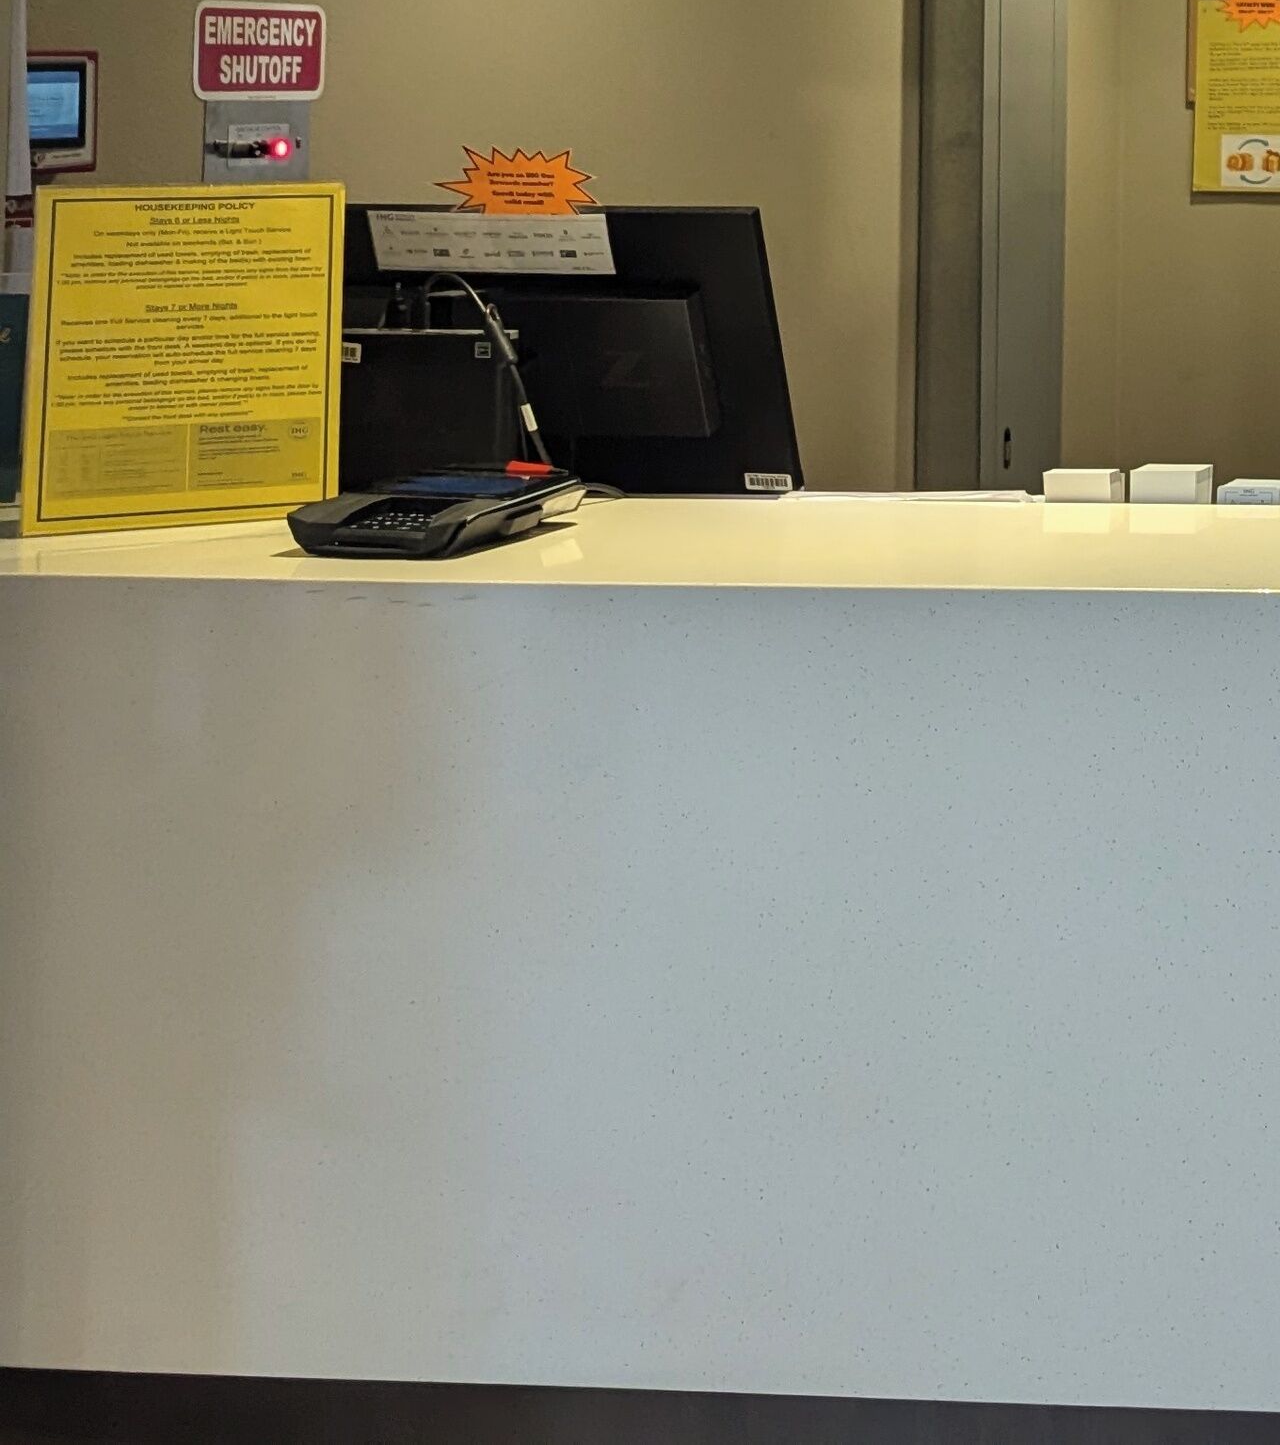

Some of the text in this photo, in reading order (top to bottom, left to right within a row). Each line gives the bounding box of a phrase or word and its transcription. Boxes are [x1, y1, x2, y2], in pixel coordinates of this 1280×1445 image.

[205, 16, 316, 46] EMERGENCY
[220, 55, 302, 84] SHUTOFF
[135, 202, 255, 211] HOUSEKEEPING POLICY
[145, 304, 169, 312] Stays
[199, 424, 267, 434] Rest easy.
